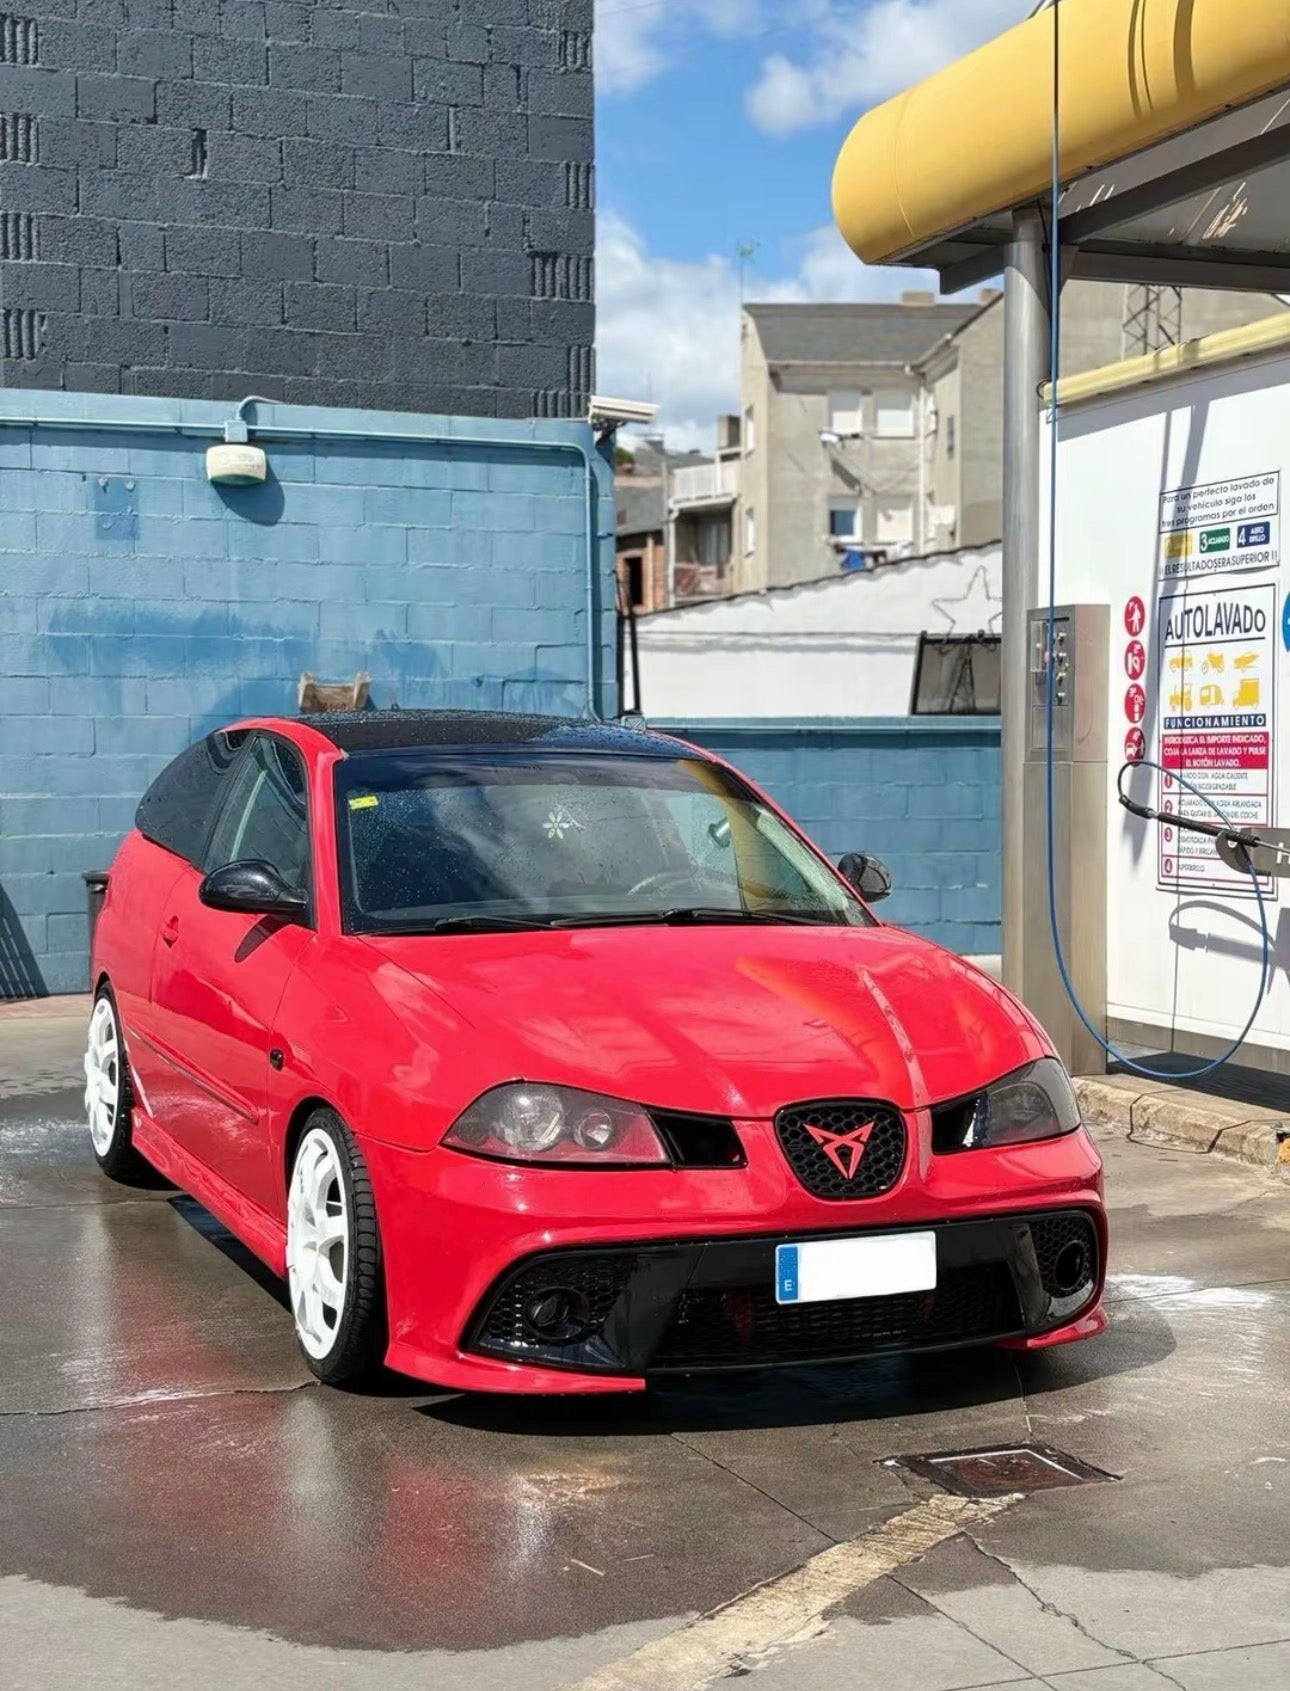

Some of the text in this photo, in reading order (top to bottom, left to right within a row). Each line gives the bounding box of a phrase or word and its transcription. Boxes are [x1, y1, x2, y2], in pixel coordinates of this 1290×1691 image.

[1193, 485, 1228, 500] perfecto
[1230, 478, 1260, 492] lavado
[1225, 495, 1242, 506] siga
[1244, 492, 1256, 501] los
[1222, 508, 1237, 519] por
[1238, 505, 1247, 514] el
[1248, 502, 1274, 513] orden
[1200, 533, 1208, 552] 3
[1238, 526, 1246, 546] 4
[1165, 602, 1266, 641] AUTOLAVADO
[1165, 715, 1265, 728] FUNCIONAMIENTO
[1217, 747, 1241, 755] LAVADO
[784, 1279, 793, 1291] E
